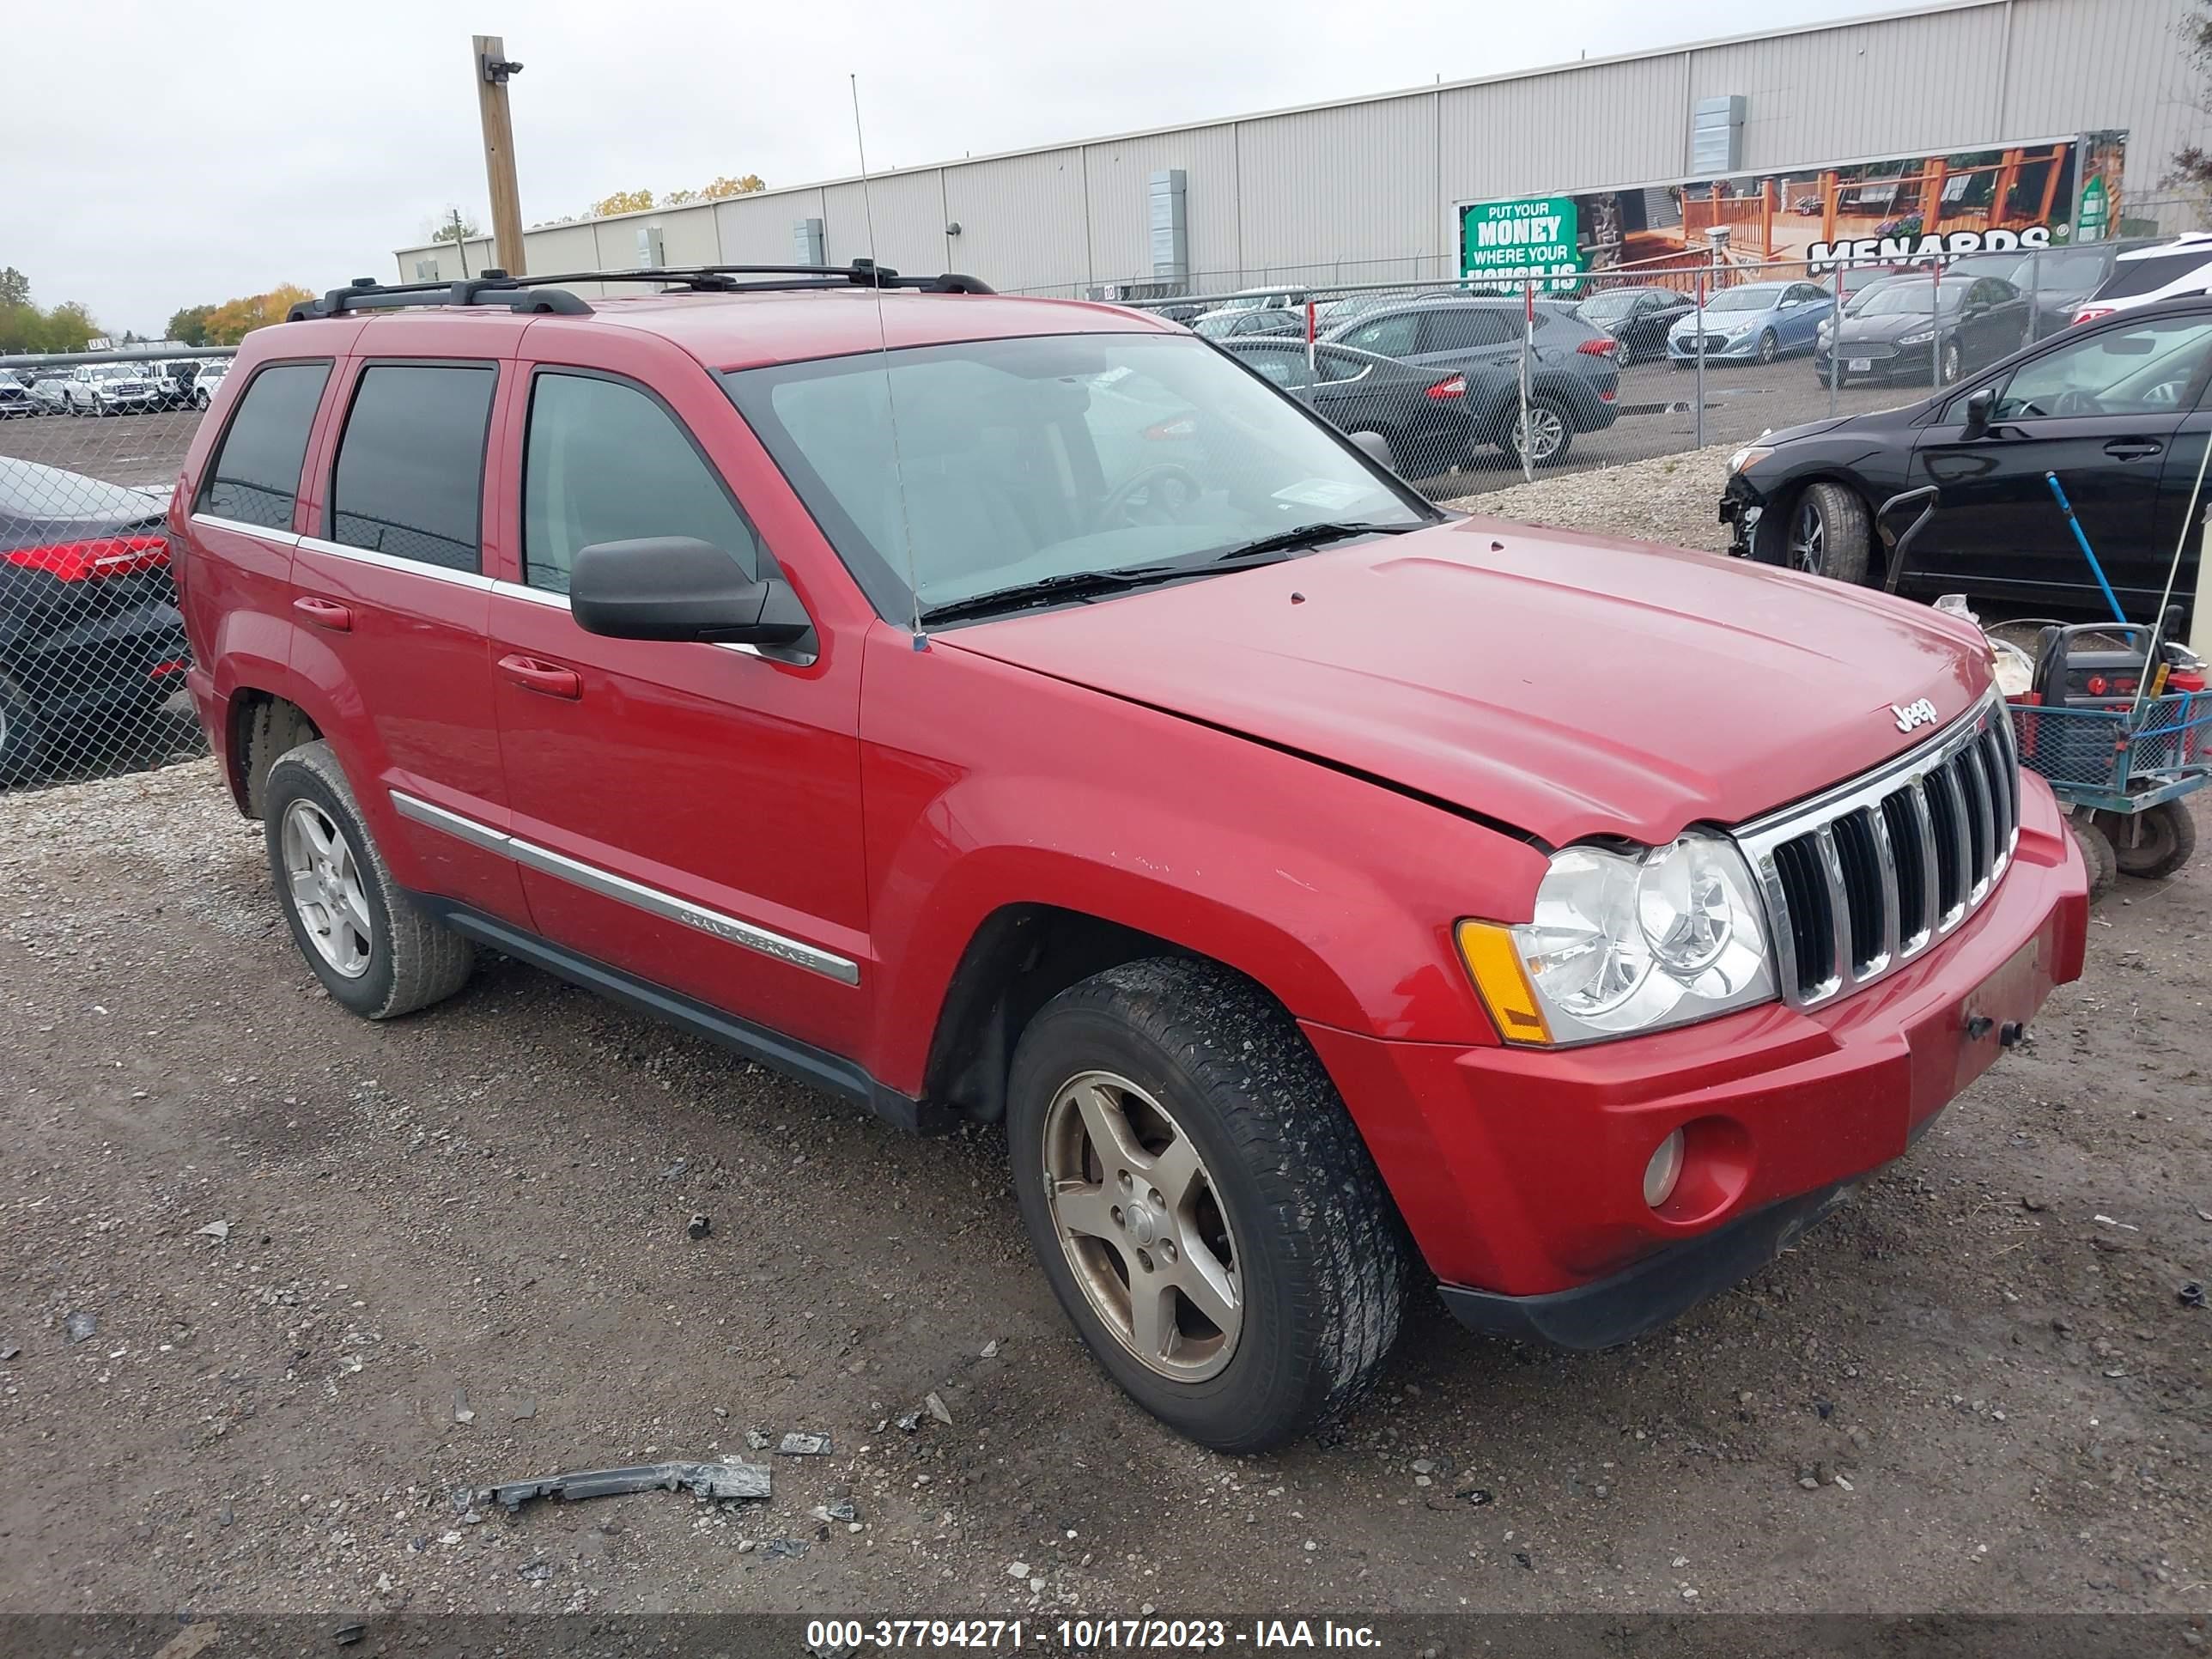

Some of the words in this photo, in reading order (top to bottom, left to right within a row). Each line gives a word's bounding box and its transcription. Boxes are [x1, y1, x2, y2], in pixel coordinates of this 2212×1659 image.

[1489, 205, 1513, 219] PUT
[1514, 203, 1549, 217] YOUR
[1478, 216, 1561, 246] MONEY
[1474, 247, 1526, 264] WHERE
[1528, 245, 1568, 262] YOUR
[1890, 698, 1937, 732] Jeep
[681, 910, 731, 936] GRAND
[735, 930, 816, 966] CHEROKEE
